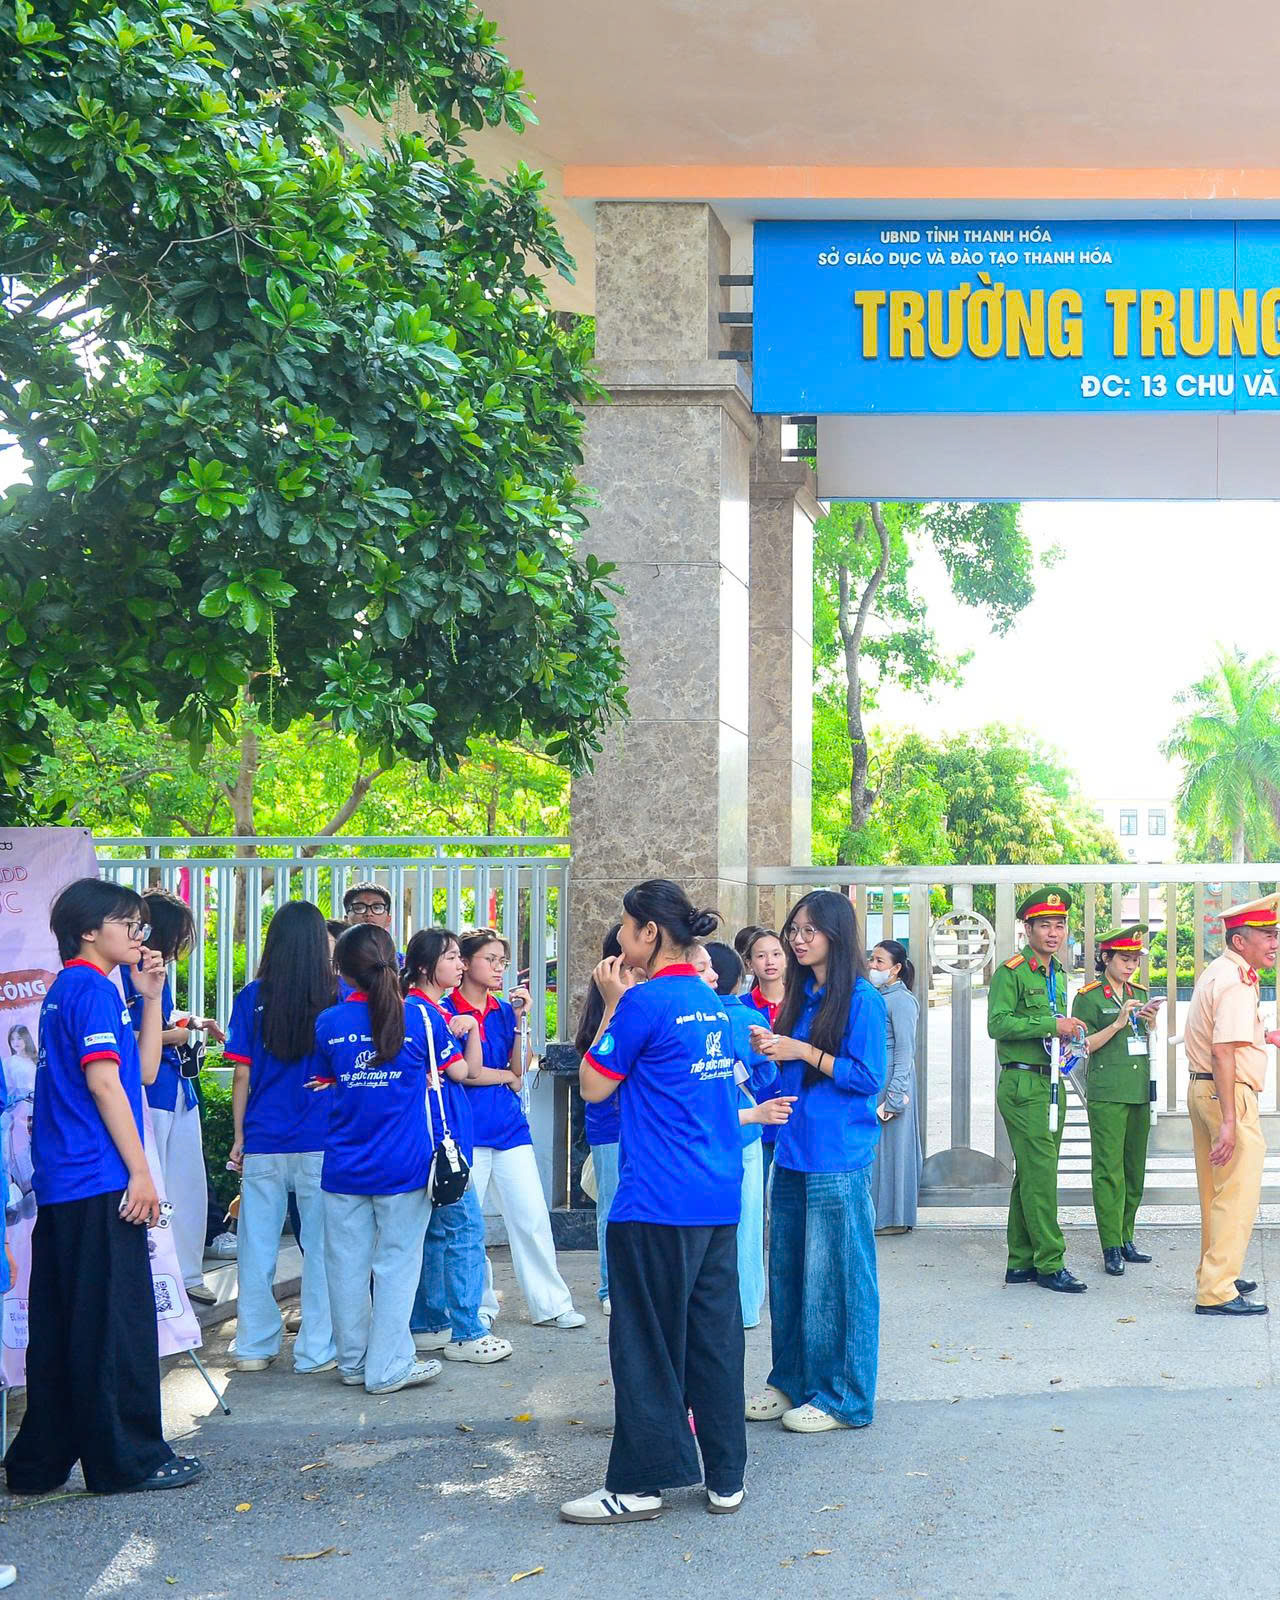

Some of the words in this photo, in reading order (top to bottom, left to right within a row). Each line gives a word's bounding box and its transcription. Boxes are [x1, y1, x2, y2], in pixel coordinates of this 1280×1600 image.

[881, 230, 920, 244] UBND
[926, 226, 959, 243] TỈNH
[964, 230, 1014, 243] THANH
[1020, 225, 1052, 243] HÓA
[818, 247, 840, 265] SỞ
[845, 248, 884, 265] GIÁO
[889, 252, 922, 268] DỤC
[927, 247, 946, 265] VÀ
[951, 247, 984, 265] ĐÀO
[989, 251, 1019, 268] TẠO
[1024, 251, 1075, 264] THANH
[1080, 247, 1113, 264] HÓA
[855, 271, 1084, 359] TRƯỜNG
[1081, 375, 1131, 398] ĐC:
[1141, 375, 1167, 397] 13
[1176, 374, 1235, 397] CHU
